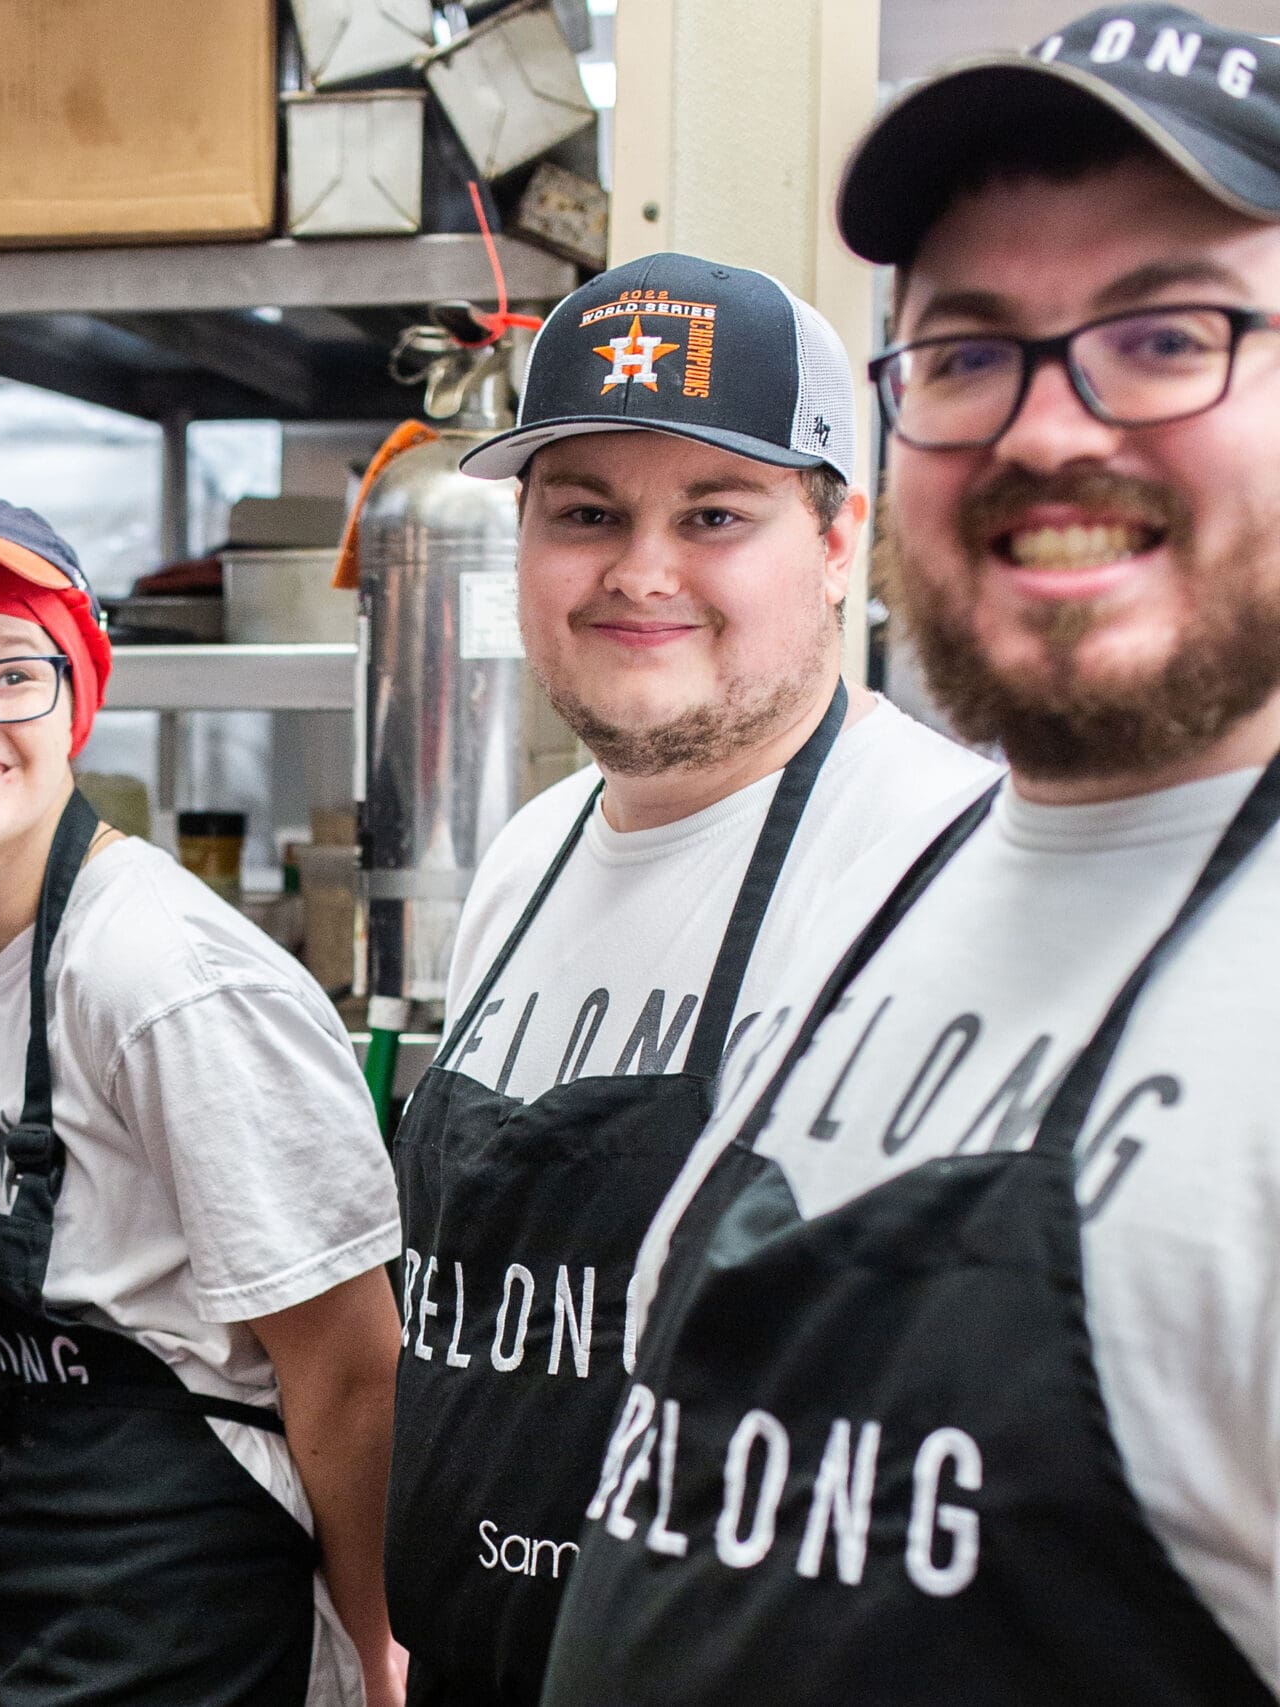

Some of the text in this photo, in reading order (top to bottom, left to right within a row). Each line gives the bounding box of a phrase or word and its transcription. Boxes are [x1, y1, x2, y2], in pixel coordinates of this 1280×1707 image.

[581, 302, 716, 324] WORLD SERIES
[620, 290, 669, 300] 2022
[603, 336, 662, 384] H
[683, 319, 714, 398] CHAMPIONS
[585, 1383, 983, 1598] BELONG
[479, 1519, 581, 1579] Sam
